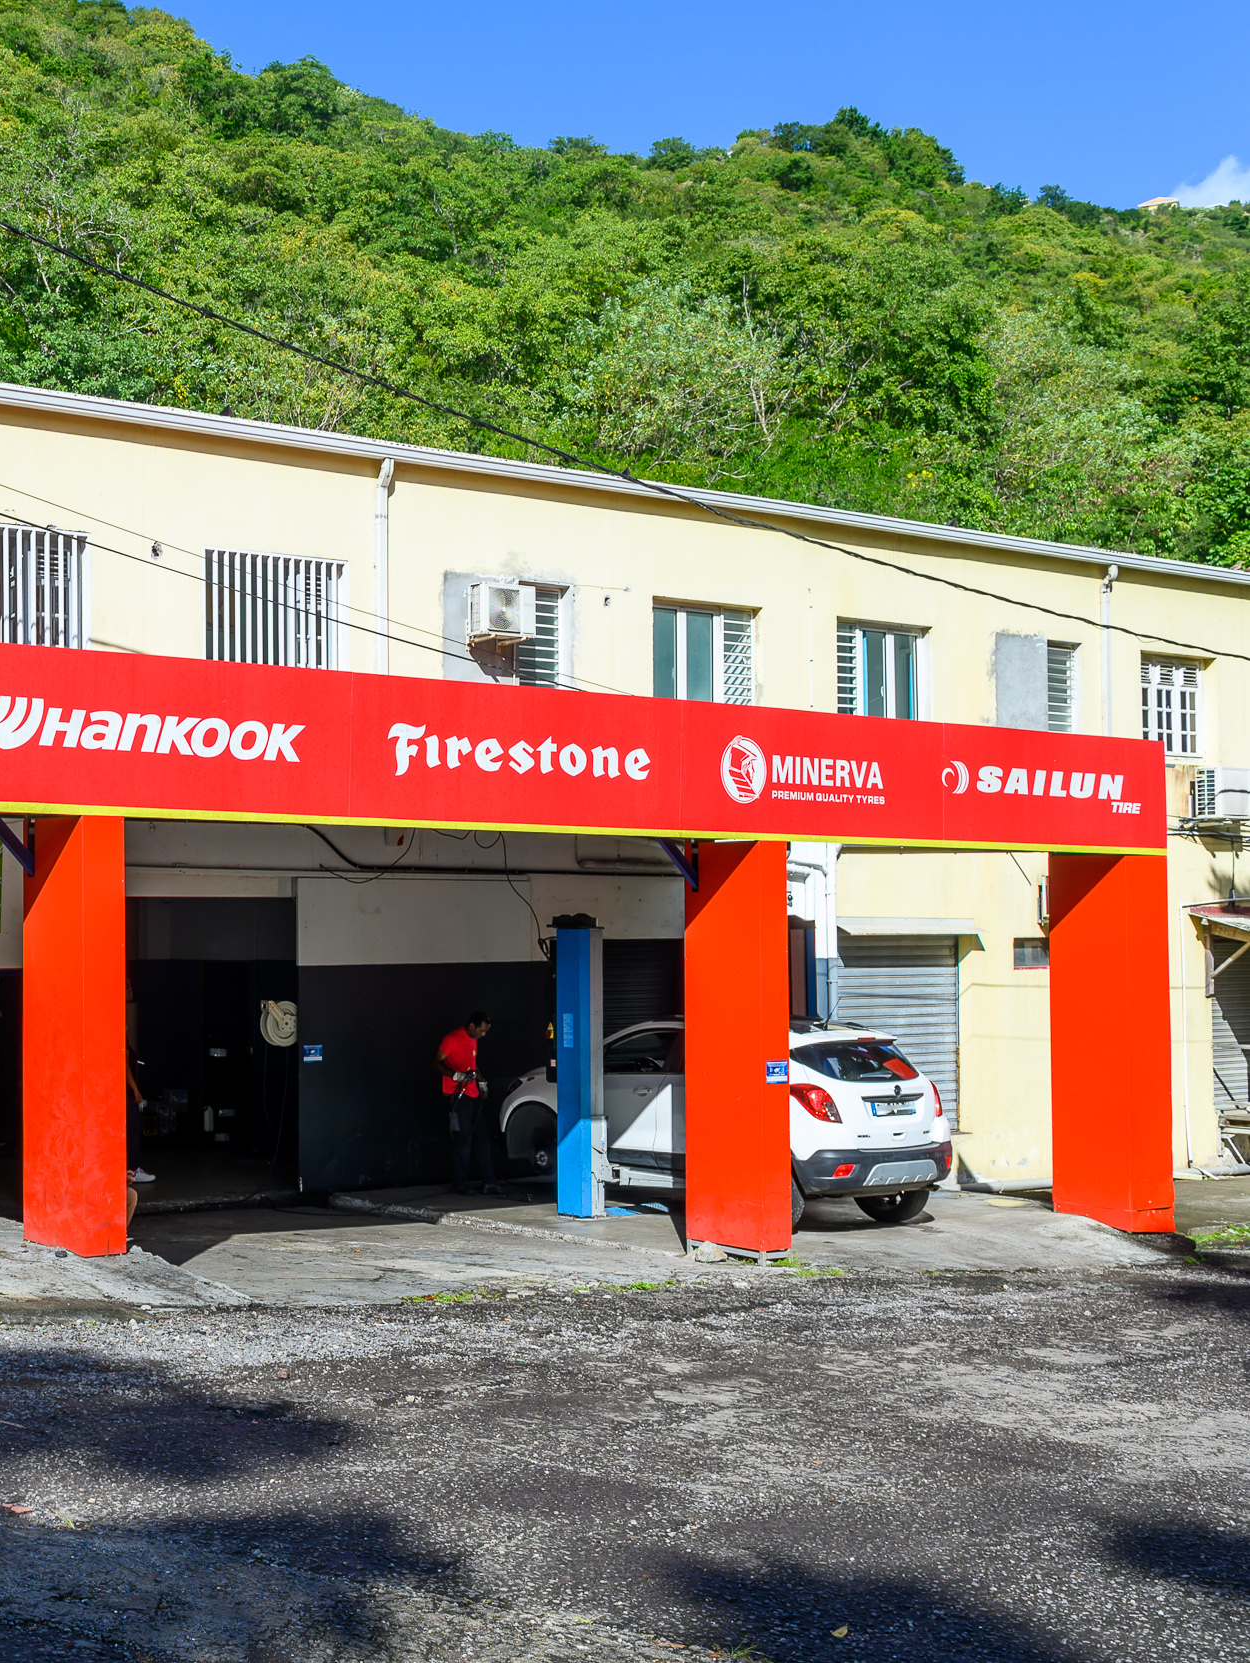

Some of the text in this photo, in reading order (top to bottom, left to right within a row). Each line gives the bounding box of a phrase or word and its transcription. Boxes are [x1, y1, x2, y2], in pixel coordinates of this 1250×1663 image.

[387, 722, 651, 781] Firestone
[771, 754, 884, 790] MINERVA
[976, 765, 1124, 801] SAILUN
[771, 789, 886, 806] PREMIUM QUALITY TYRES
[1110, 801, 1142, 815] TIRE
